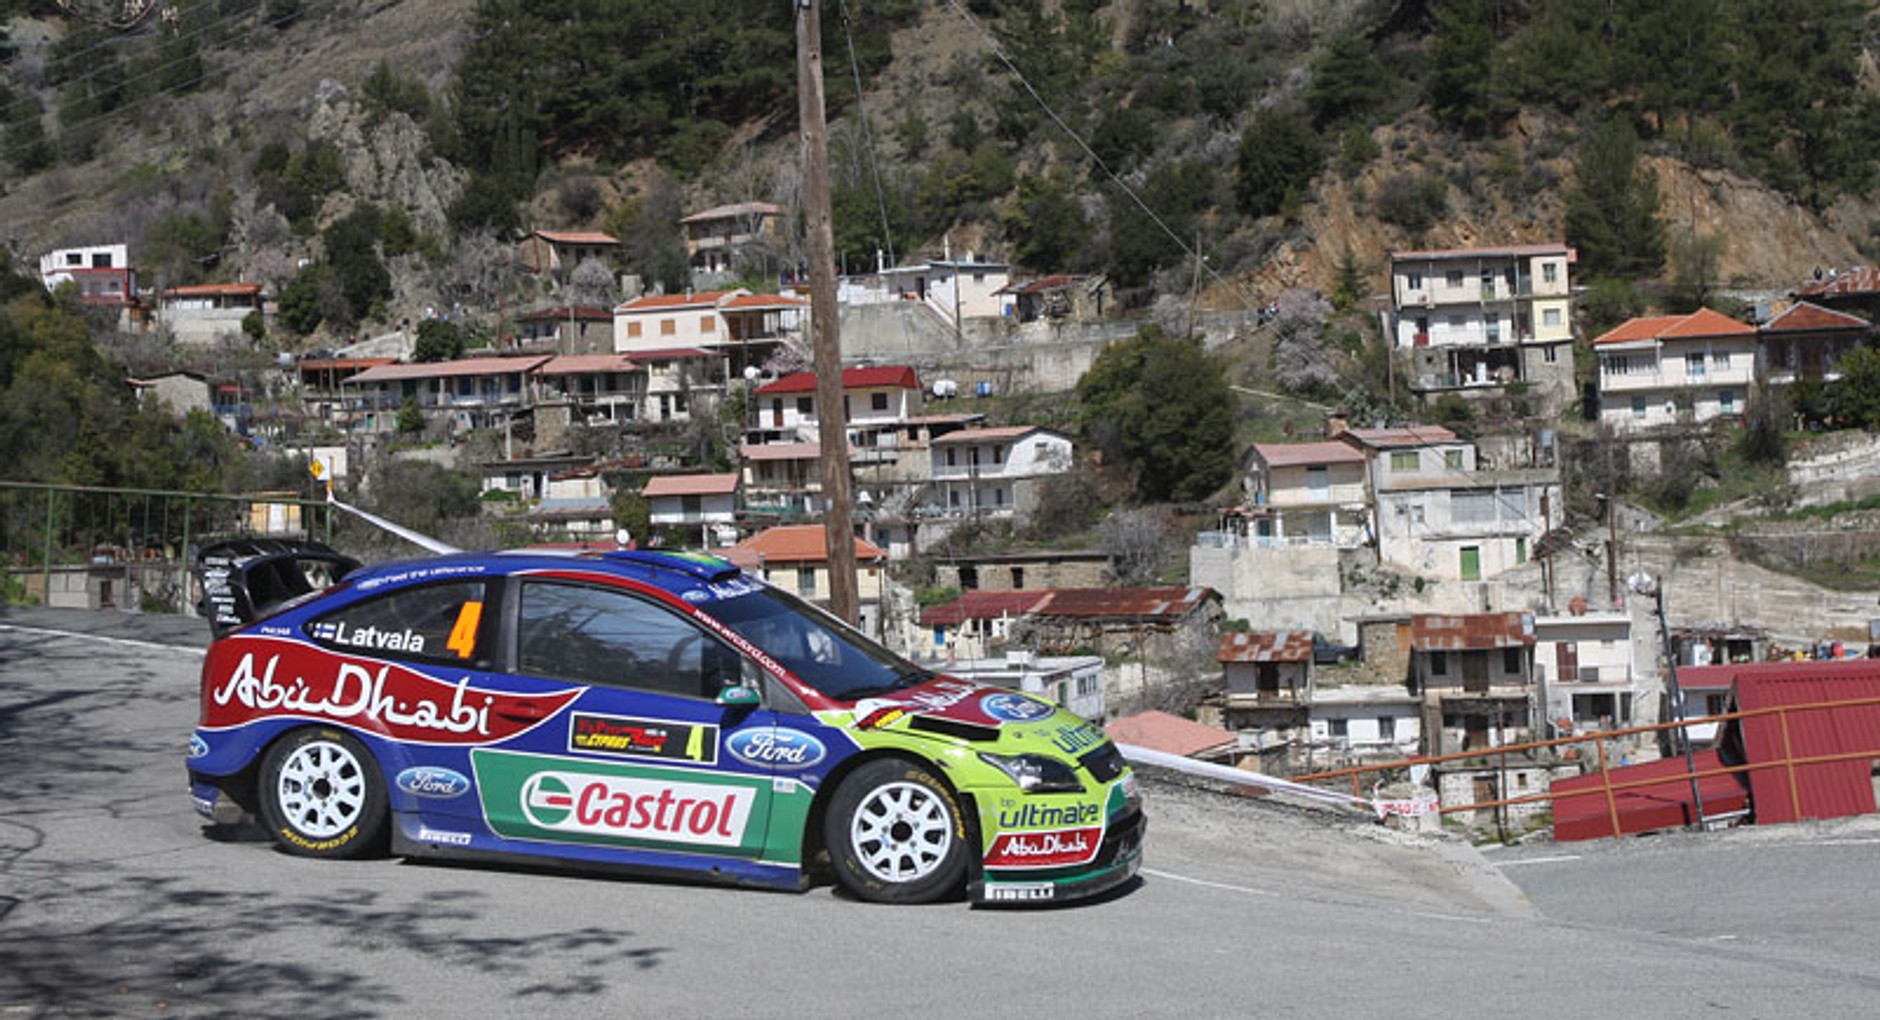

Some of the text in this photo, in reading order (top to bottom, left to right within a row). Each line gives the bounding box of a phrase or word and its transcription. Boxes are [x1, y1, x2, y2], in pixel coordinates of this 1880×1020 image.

[334, 621, 425, 653] Latvala
[446, 601, 483, 659] 4
[213, 652, 495, 735] Abu Dhabi
[685, 725, 704, 761] 4
[743, 733, 806, 764] Ford
[408, 769, 456, 792] Ford
[576, 781, 737, 837] Castrol
[1000, 801, 1099, 828] ultimate
[1001, 836, 1039, 856] Abu
